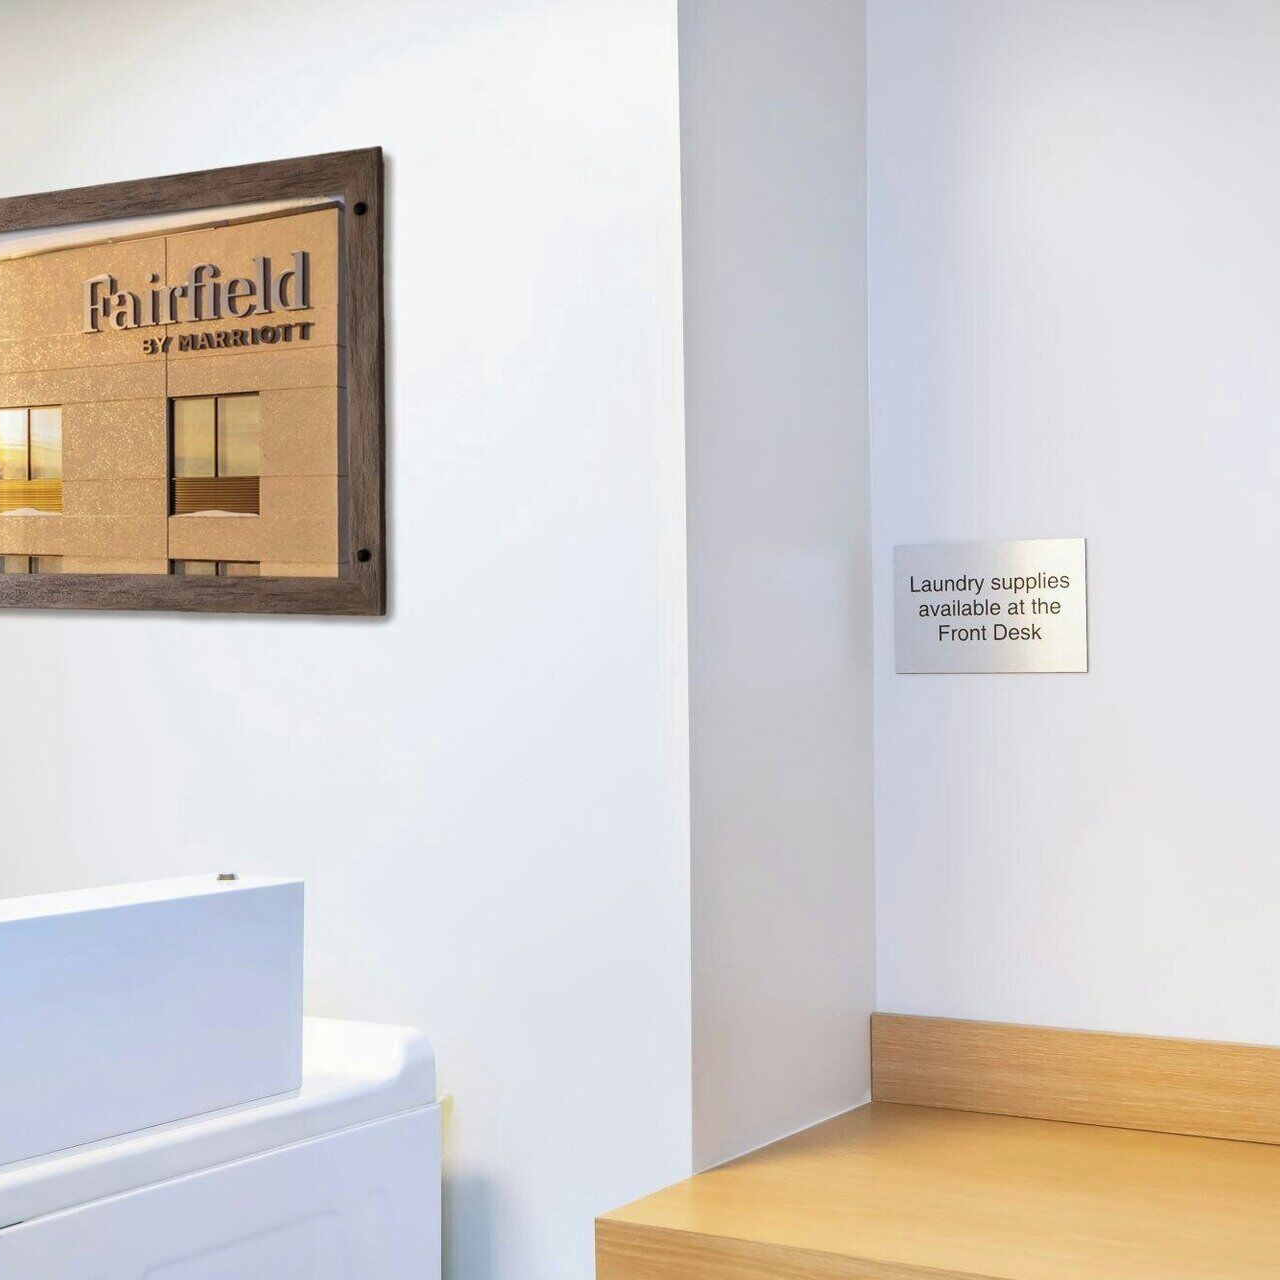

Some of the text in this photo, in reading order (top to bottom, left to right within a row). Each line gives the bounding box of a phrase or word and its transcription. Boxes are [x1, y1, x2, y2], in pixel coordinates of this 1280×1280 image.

[81, 250, 312, 334] Fairfield
[142, 322, 314, 355] BY MARRIOTT
[909, 572, 1070, 596] Laundry supplies
[918, 598, 1061, 618] available at the
[938, 623, 1043, 642] Front Desk
